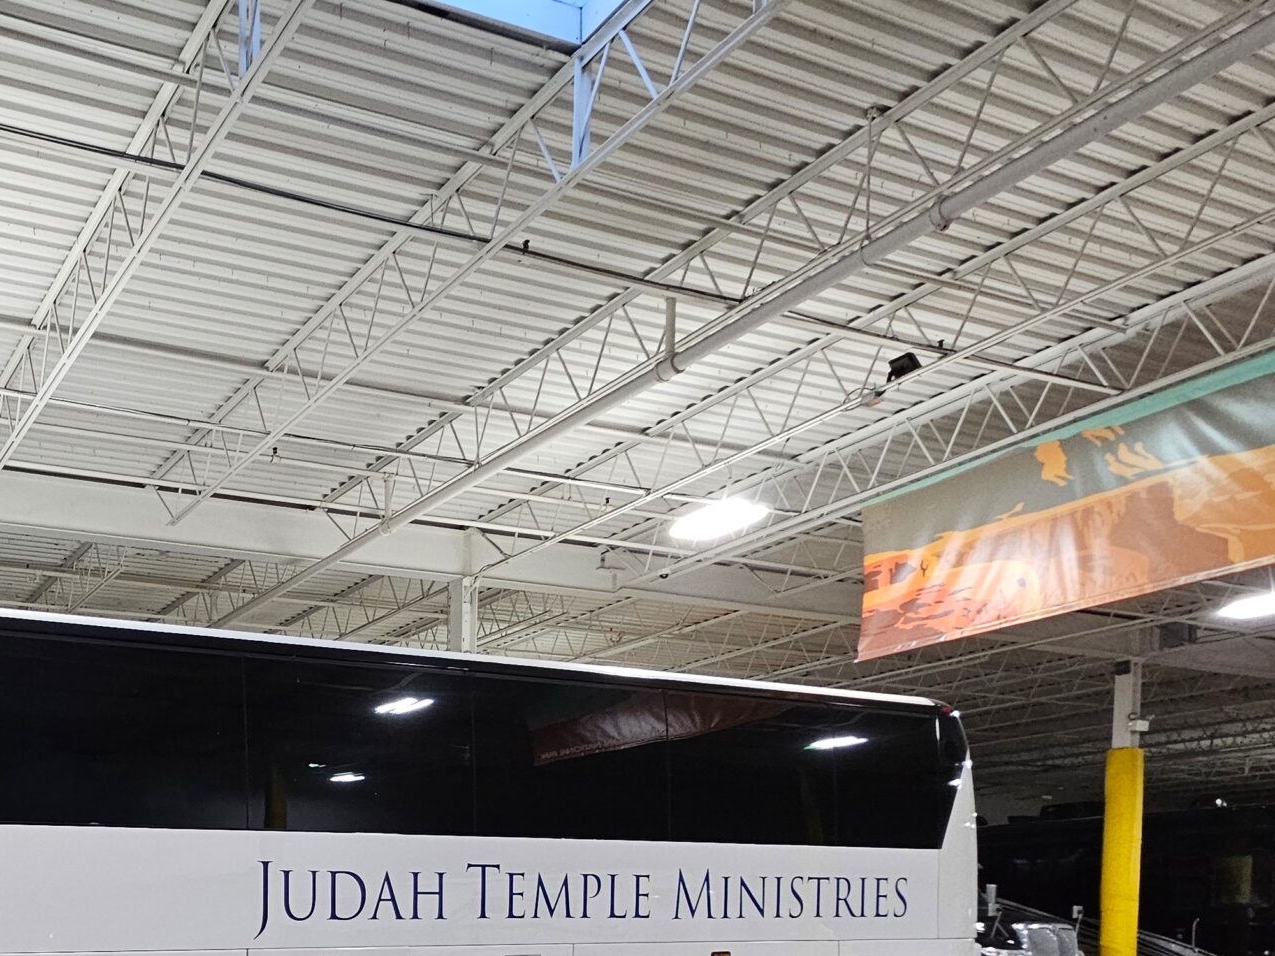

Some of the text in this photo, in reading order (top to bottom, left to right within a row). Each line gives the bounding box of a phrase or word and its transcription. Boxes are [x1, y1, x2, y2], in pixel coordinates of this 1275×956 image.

[253, 860, 909, 940] JUDAH TEMPLE MINISTRIES
